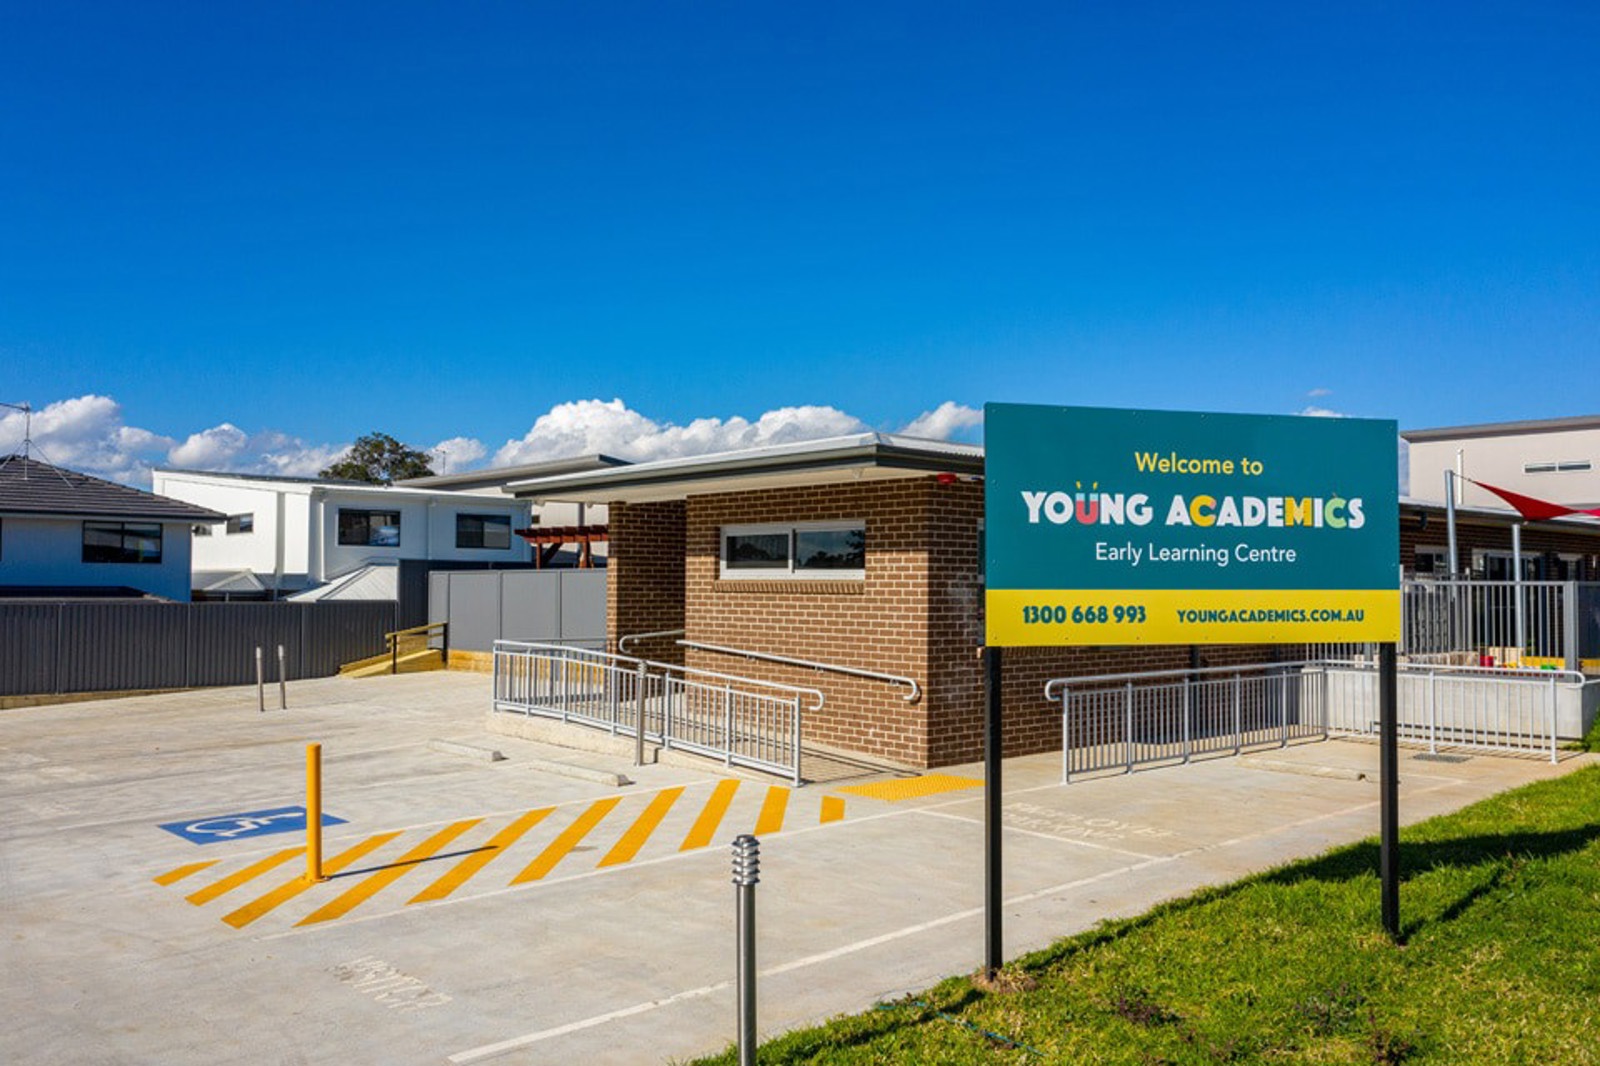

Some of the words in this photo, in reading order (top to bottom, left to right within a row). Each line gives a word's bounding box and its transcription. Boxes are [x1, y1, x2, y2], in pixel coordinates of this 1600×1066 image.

[1135, 452, 1234, 475] Welcome
[1240, 457, 1264, 476] to
[1021, 483, 1153, 525] YOUNG
[1166, 494, 1365, 528] ACADEMICS
[1096, 541, 1142, 566] Early
[1149, 543, 1229, 567] Learning
[1235, 543, 1296, 562] Centre
[1023, 605, 1067, 624] 1300
[1070, 605, 1110, 624] 668
[1112, 604, 1147, 623] 993
[1177, 609, 1364, 623] YOUNGACADEMICS.COM.AU
